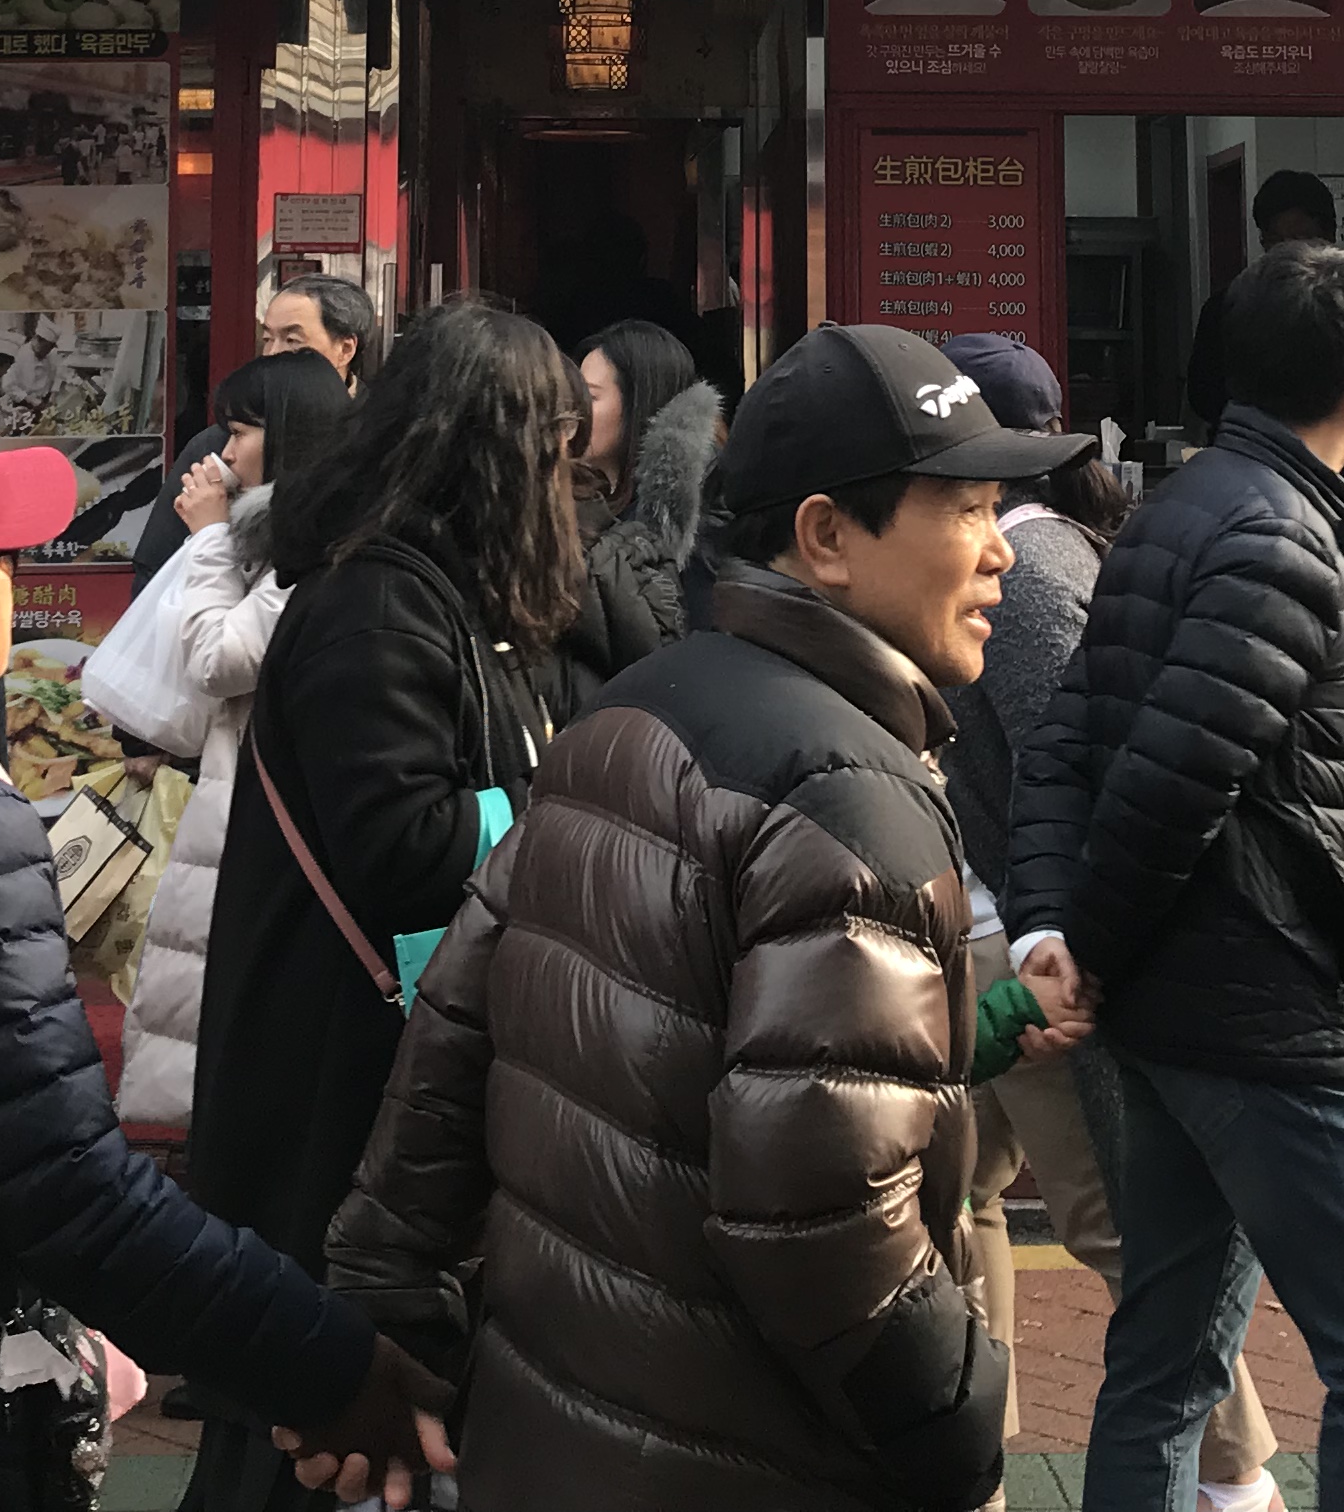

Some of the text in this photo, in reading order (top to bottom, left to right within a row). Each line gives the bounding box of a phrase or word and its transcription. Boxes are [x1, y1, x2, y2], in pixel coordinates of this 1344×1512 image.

[33, 34, 68, 54] 했다
[947, 43, 987, 59] 뜨거울
[989, 43, 1003, 58] 수
[1262, 44, 1313, 60] 뜨거우니
[885, 59, 924, 75] 있으니
[873, 154, 1025, 187] 生煎包柜台
[987, 214, 1025, 231] 3,000
[987, 243, 1026, 259] 4,000
[987, 271, 1026, 288] 4,000
[988, 301, 1026, 317] 5,000
